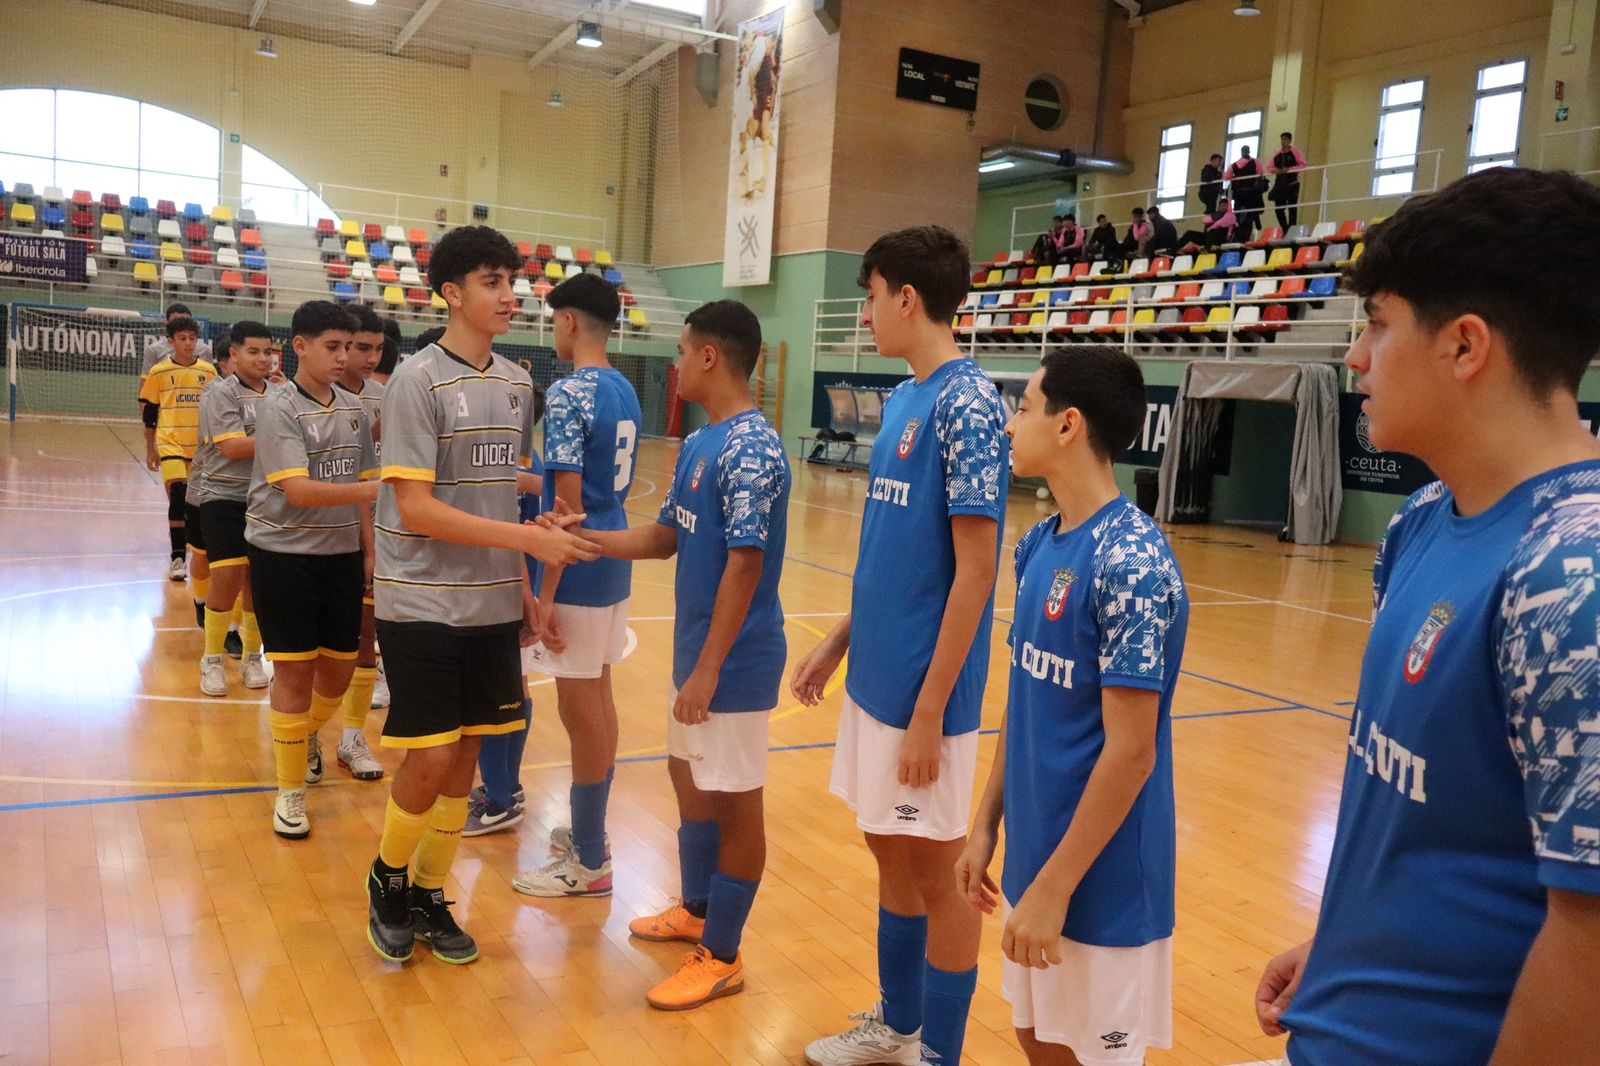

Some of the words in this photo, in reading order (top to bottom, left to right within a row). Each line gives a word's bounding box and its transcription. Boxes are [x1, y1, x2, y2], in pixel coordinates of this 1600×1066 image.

[903, 69, 925, 80] LOCAL
[5, 243, 40, 258] FÚTBOL
[43, 246, 66, 260] SALA
[15, 262, 66, 277] Iberdrola
[243, 403, 257, 419] 14
[307, 423, 320, 443] 4
[613, 420, 636, 492] 3
[1350, 457, 1396, 472] ceuta
[1104, 1042, 1128, 1050] umbro
